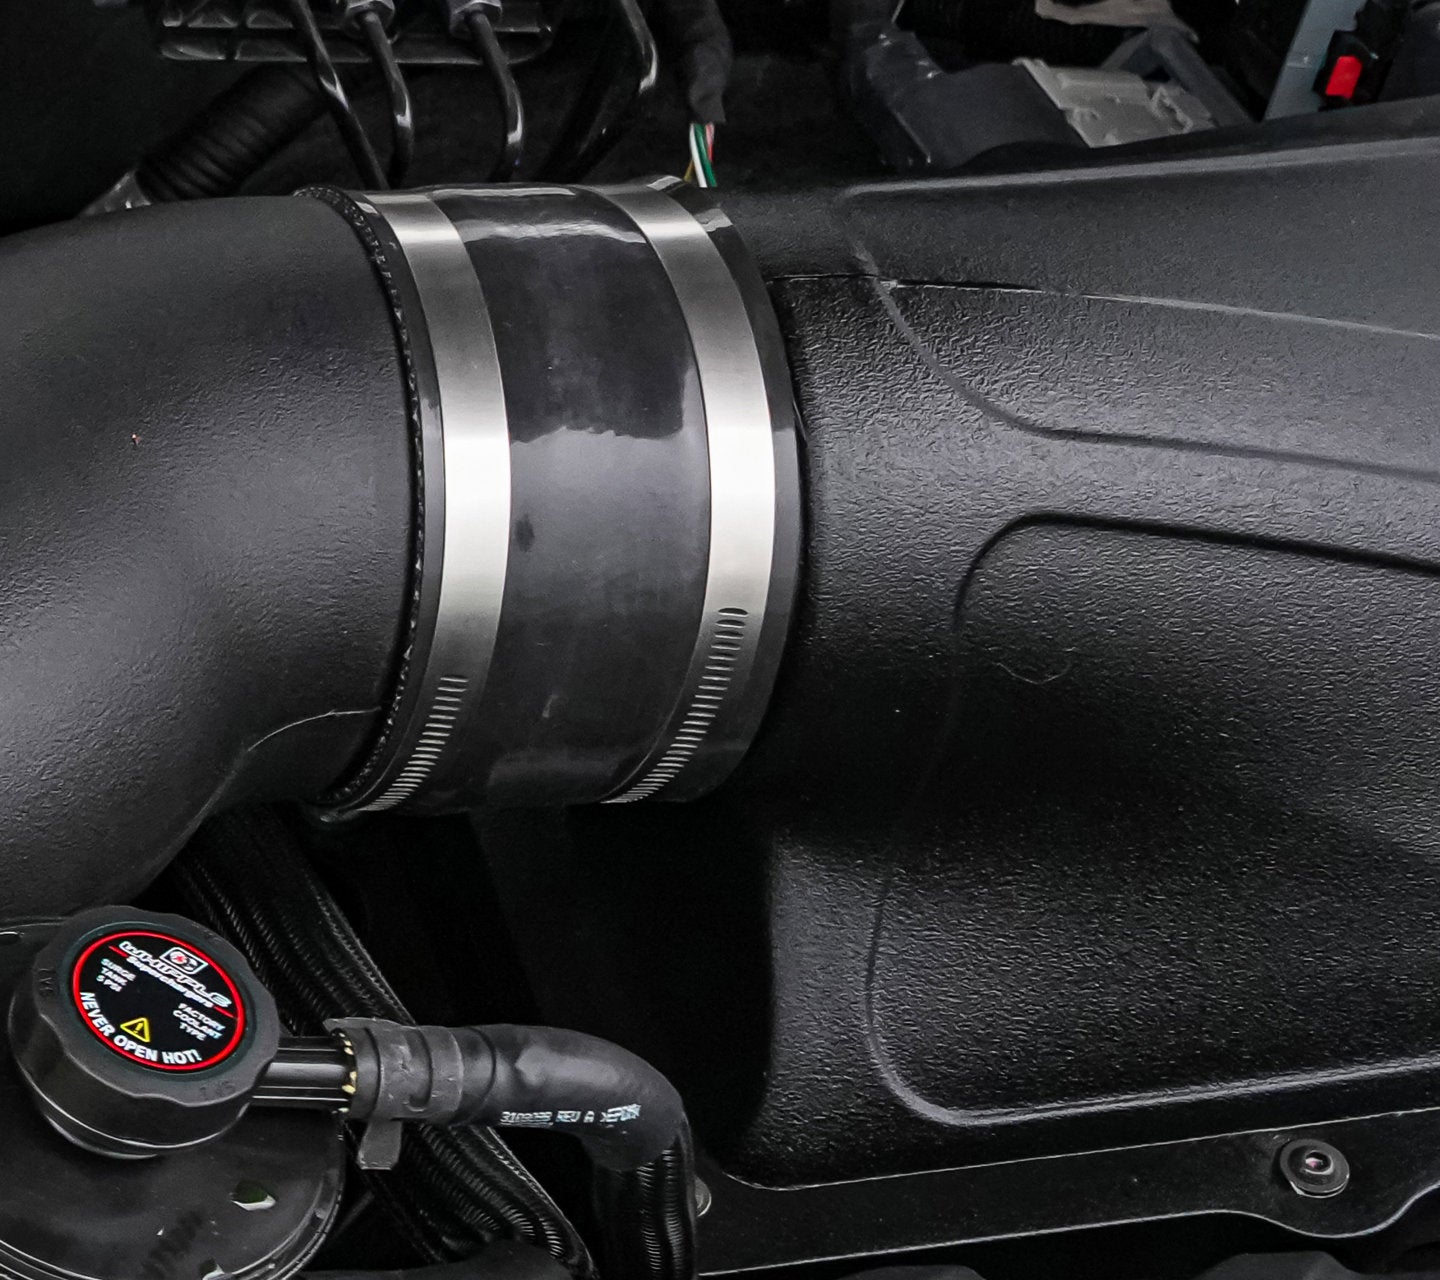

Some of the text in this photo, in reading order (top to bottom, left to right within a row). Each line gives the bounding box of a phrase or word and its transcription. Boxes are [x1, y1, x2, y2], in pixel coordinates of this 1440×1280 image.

[100, 958, 137, 982] SURGE
[119, 941, 232, 1007] WHIPPLE
[125, 956, 215, 1009] Superchargers
[104, 978, 123, 993] PSI
[80, 991, 203, 1065] NEVER OPEN HOT!
[172, 1010, 223, 1040] COOLANT
[178, 1002, 226, 1031] FACTORY
[179, 1021, 207, 1042] TYPE
